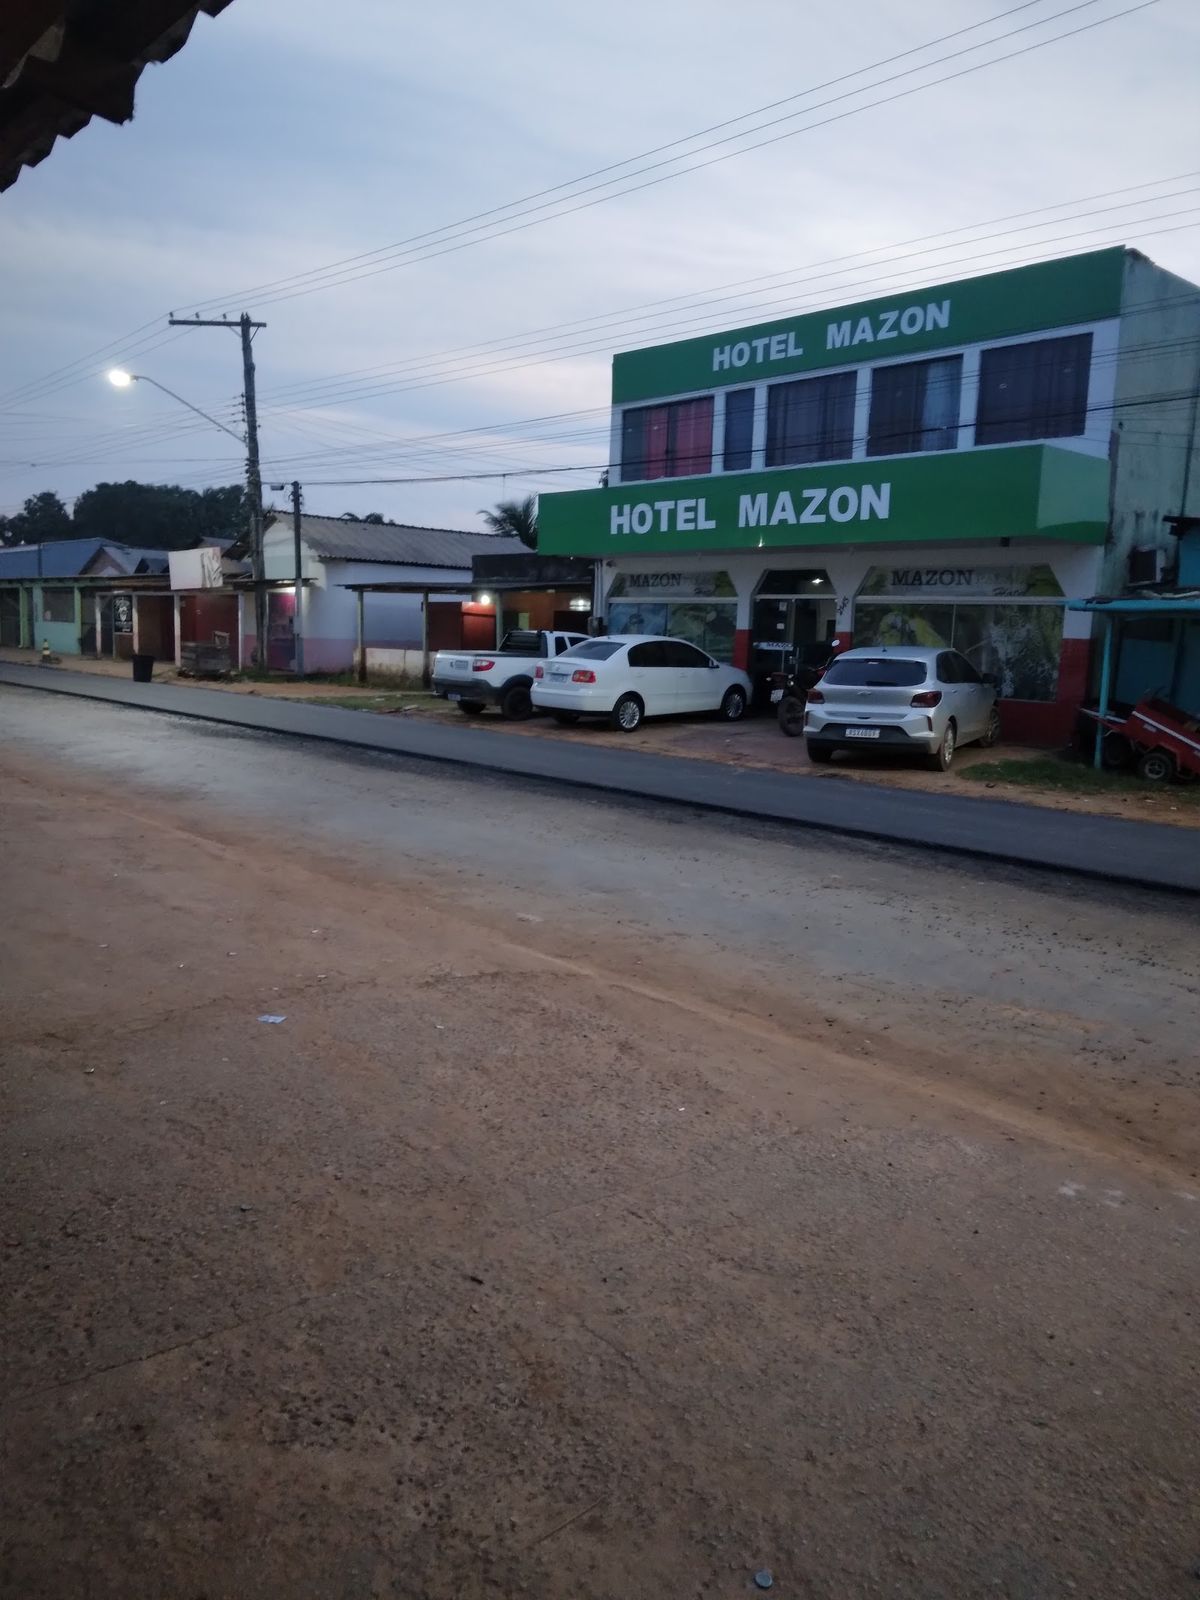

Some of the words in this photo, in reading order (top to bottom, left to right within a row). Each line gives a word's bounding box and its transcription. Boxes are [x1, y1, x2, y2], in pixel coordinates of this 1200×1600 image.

[713, 333, 803, 372] HOTEL
[826, 300, 951, 350] MAZON
[610, 498, 716, 534] HOTEL
[738, 484, 891, 527] MAZON
[630, 573, 682, 588] MAZON
[891, 569, 975, 586] MAZON
